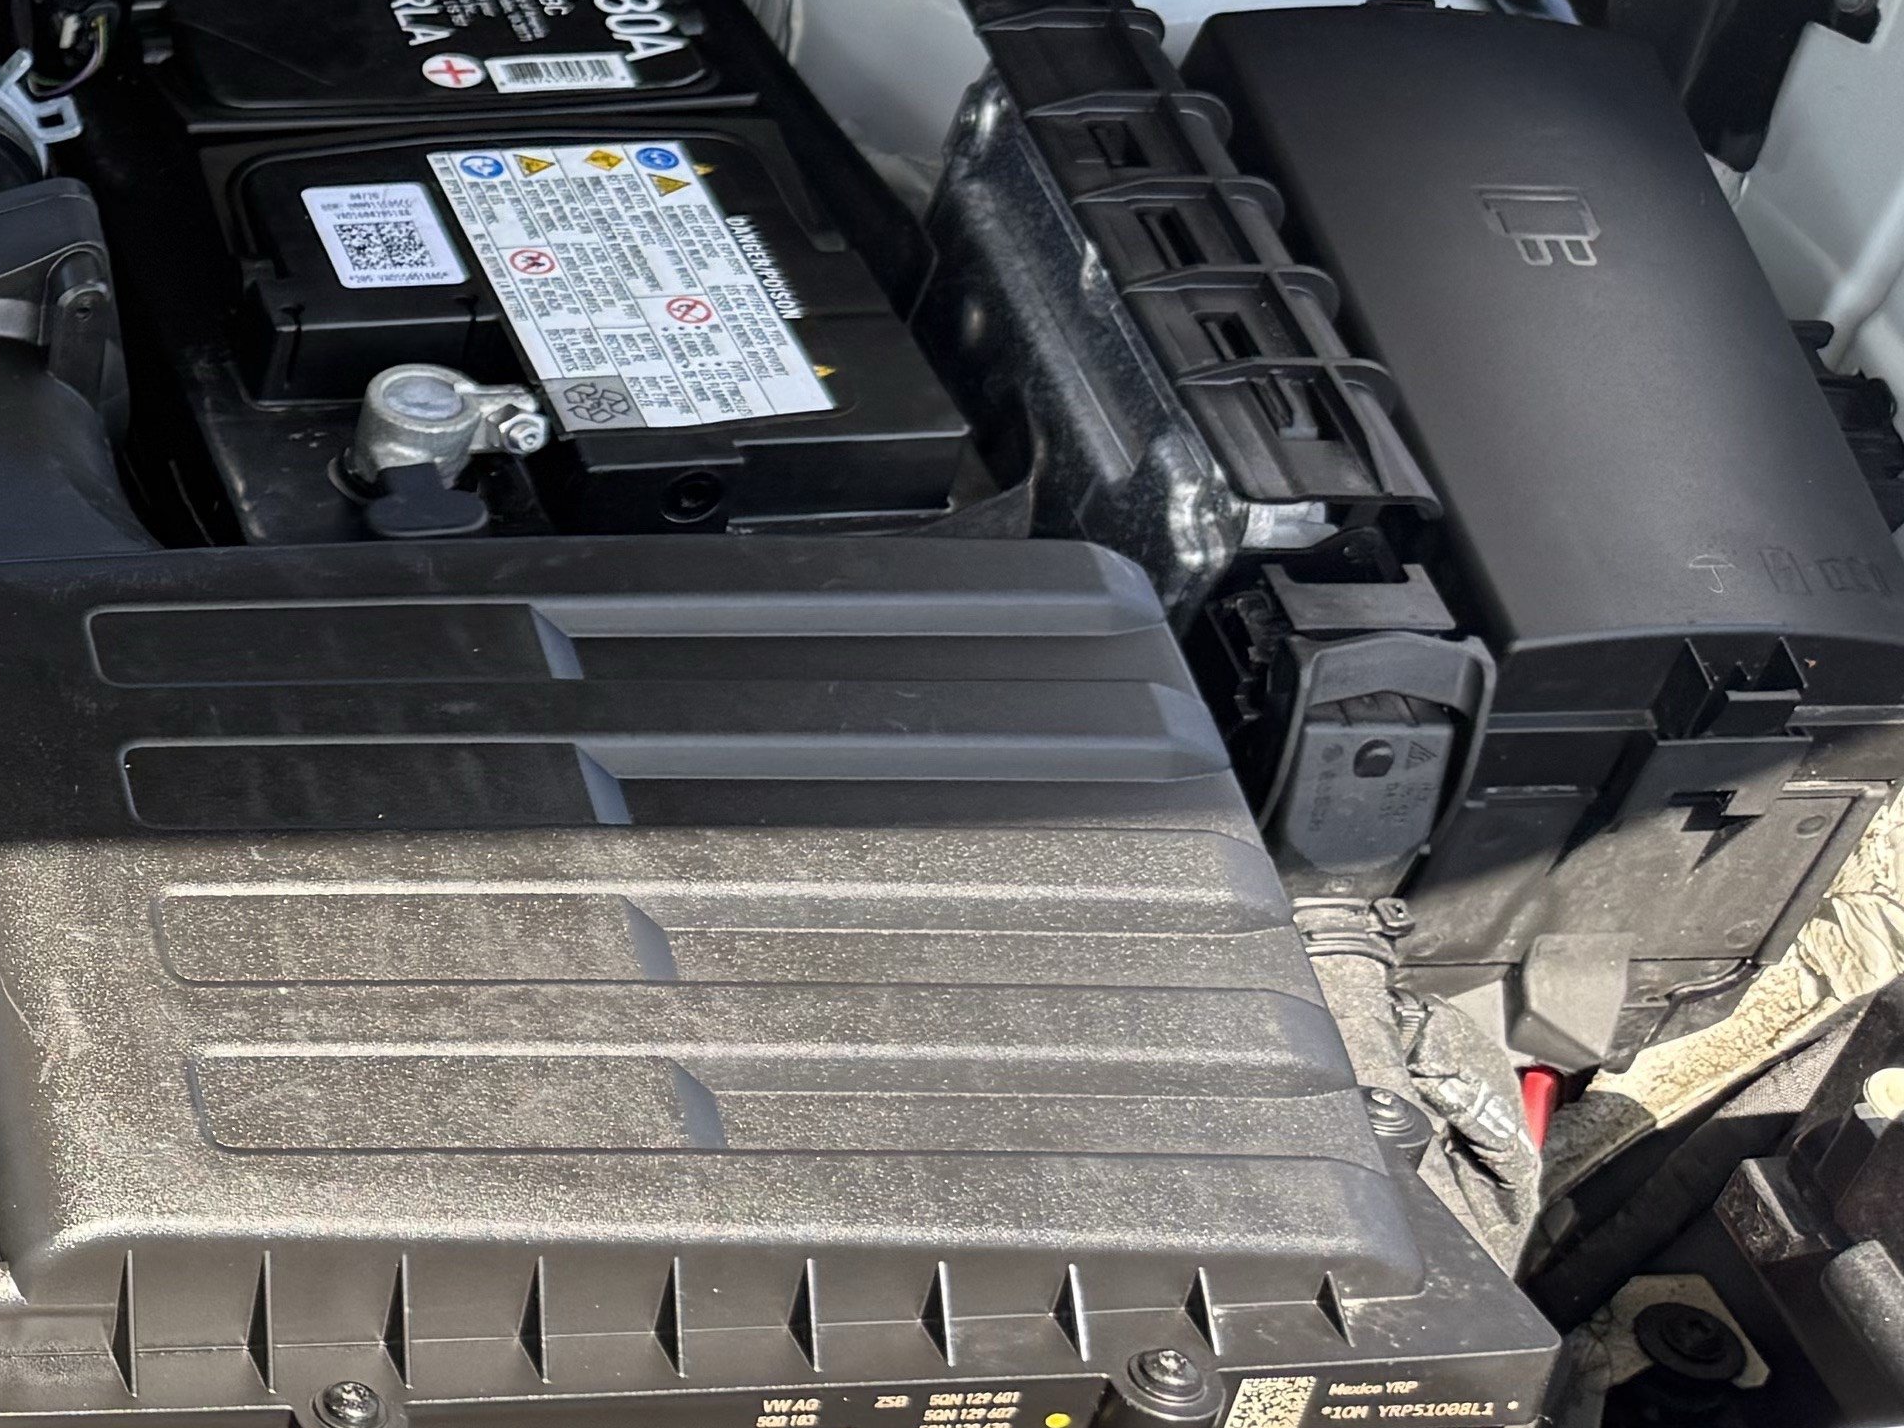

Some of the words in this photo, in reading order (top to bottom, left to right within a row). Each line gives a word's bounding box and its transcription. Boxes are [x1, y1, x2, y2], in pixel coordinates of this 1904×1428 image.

[723, 215, 808, 320] DANGER/POISON
[1328, 1382, 1382, 1397] Mexico
[763, 1398, 792, 1413] VW
